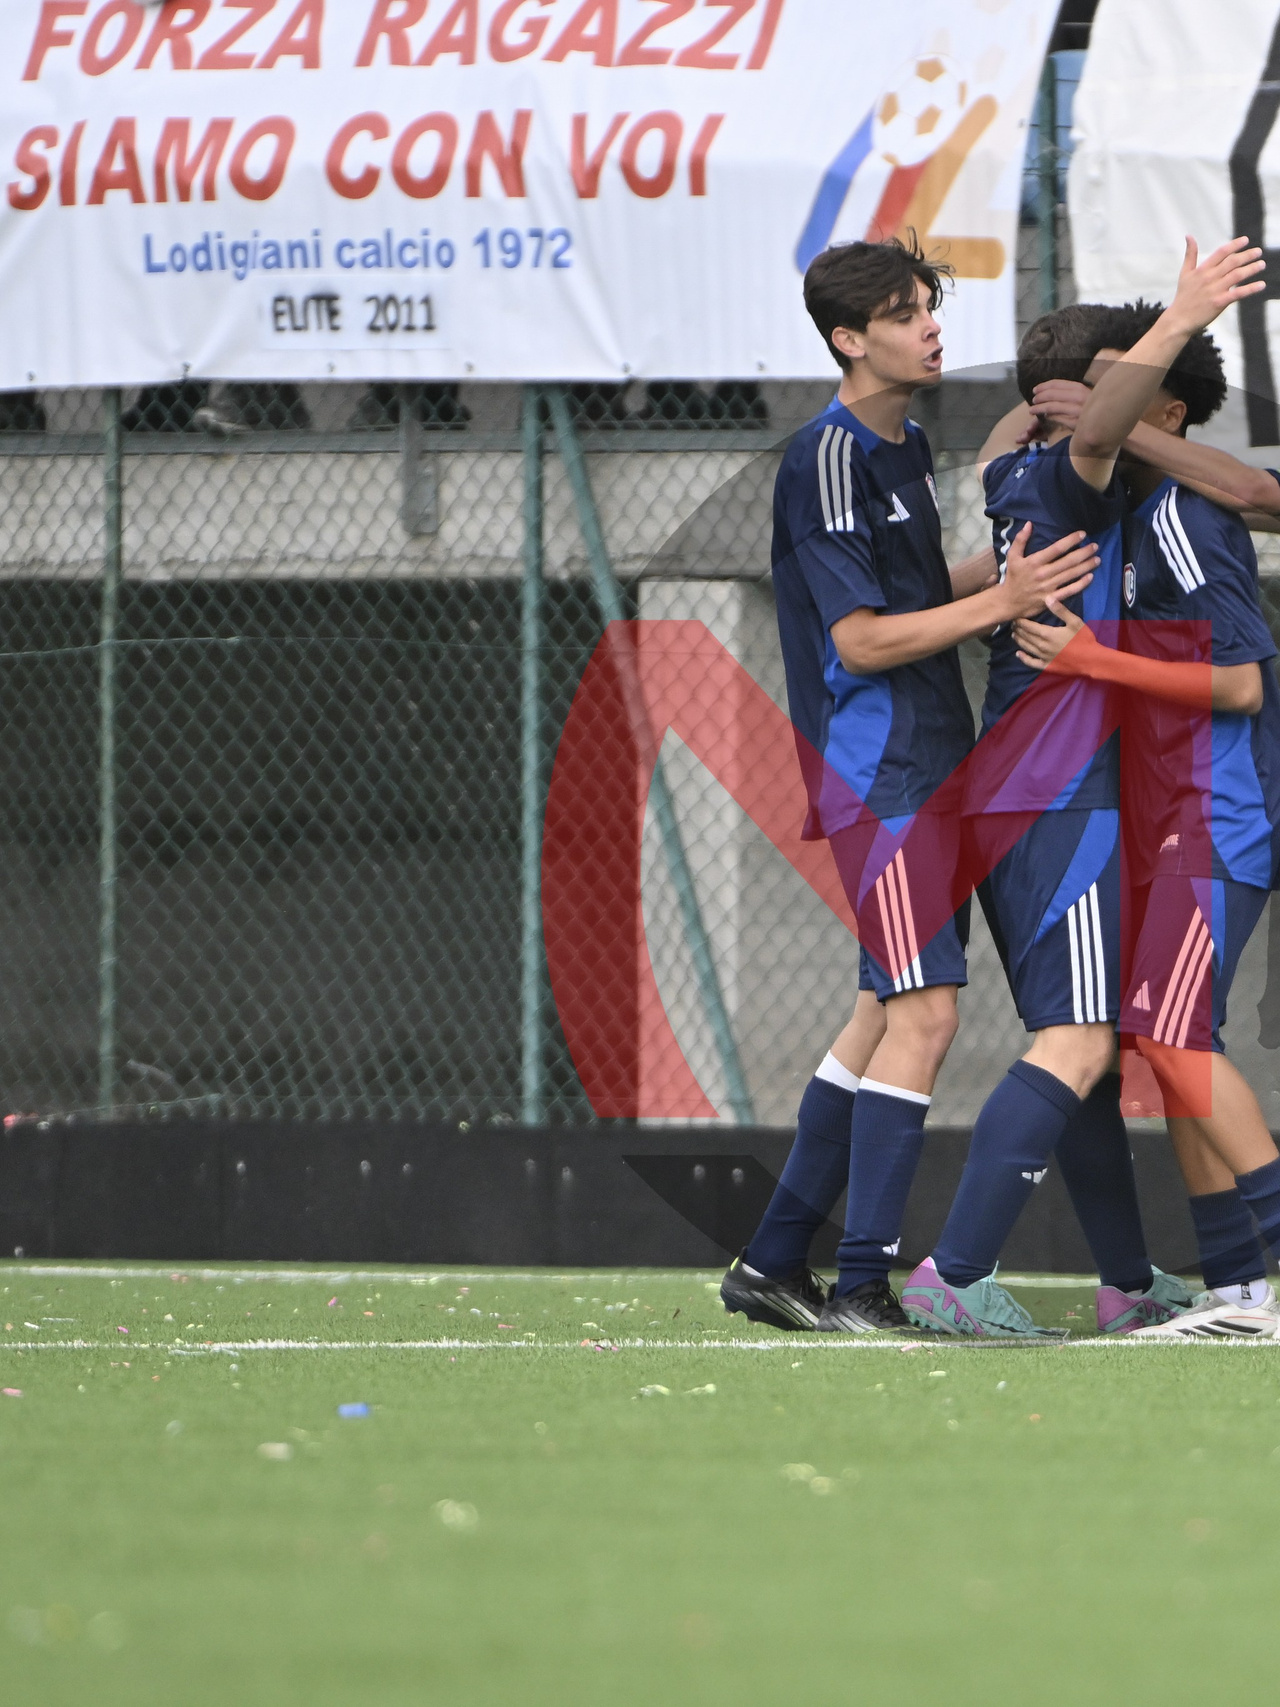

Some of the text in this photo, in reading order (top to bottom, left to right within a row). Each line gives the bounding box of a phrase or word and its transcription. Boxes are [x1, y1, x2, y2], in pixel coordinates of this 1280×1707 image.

[22, 0, 784, 81] FORZA RAGAZZI
[5, 108, 726, 212] SIAMO CON VOI
[144, 226, 574, 281] Lodigiani calcio 1972
[271, 292, 438, 334] ELITE 2011
